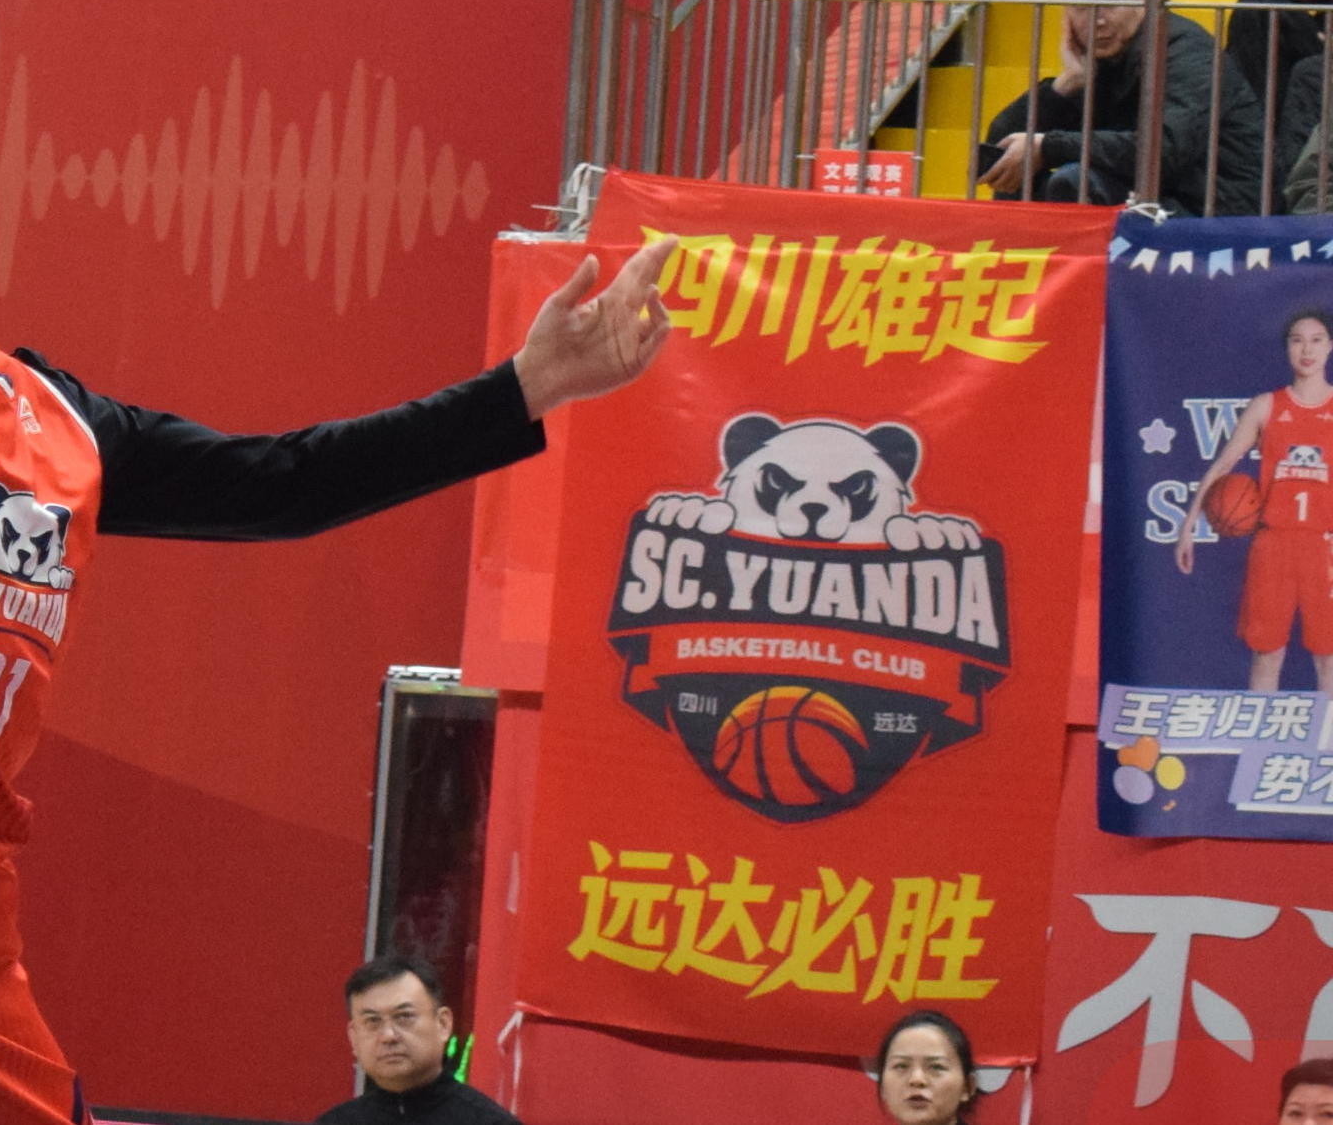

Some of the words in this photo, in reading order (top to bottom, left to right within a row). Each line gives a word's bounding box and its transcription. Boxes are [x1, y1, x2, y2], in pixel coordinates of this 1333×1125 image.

[639, 225, 1060, 367] 四川雄起
[1294, 491, 1309, 522] 1
[621, 528, 1000, 649] SC.YUANDA
[677, 637, 843, 666] BASKETBALL
[852, 648, 927, 681] CLUB
[678, 692, 718, 715] 四川
[873, 711, 918, 733] 远达
[1114, 691, 1313, 742] 王者归来
[567, 839, 999, 1004] 远达必胜
[1055, 893, 1333, 1109] 不
